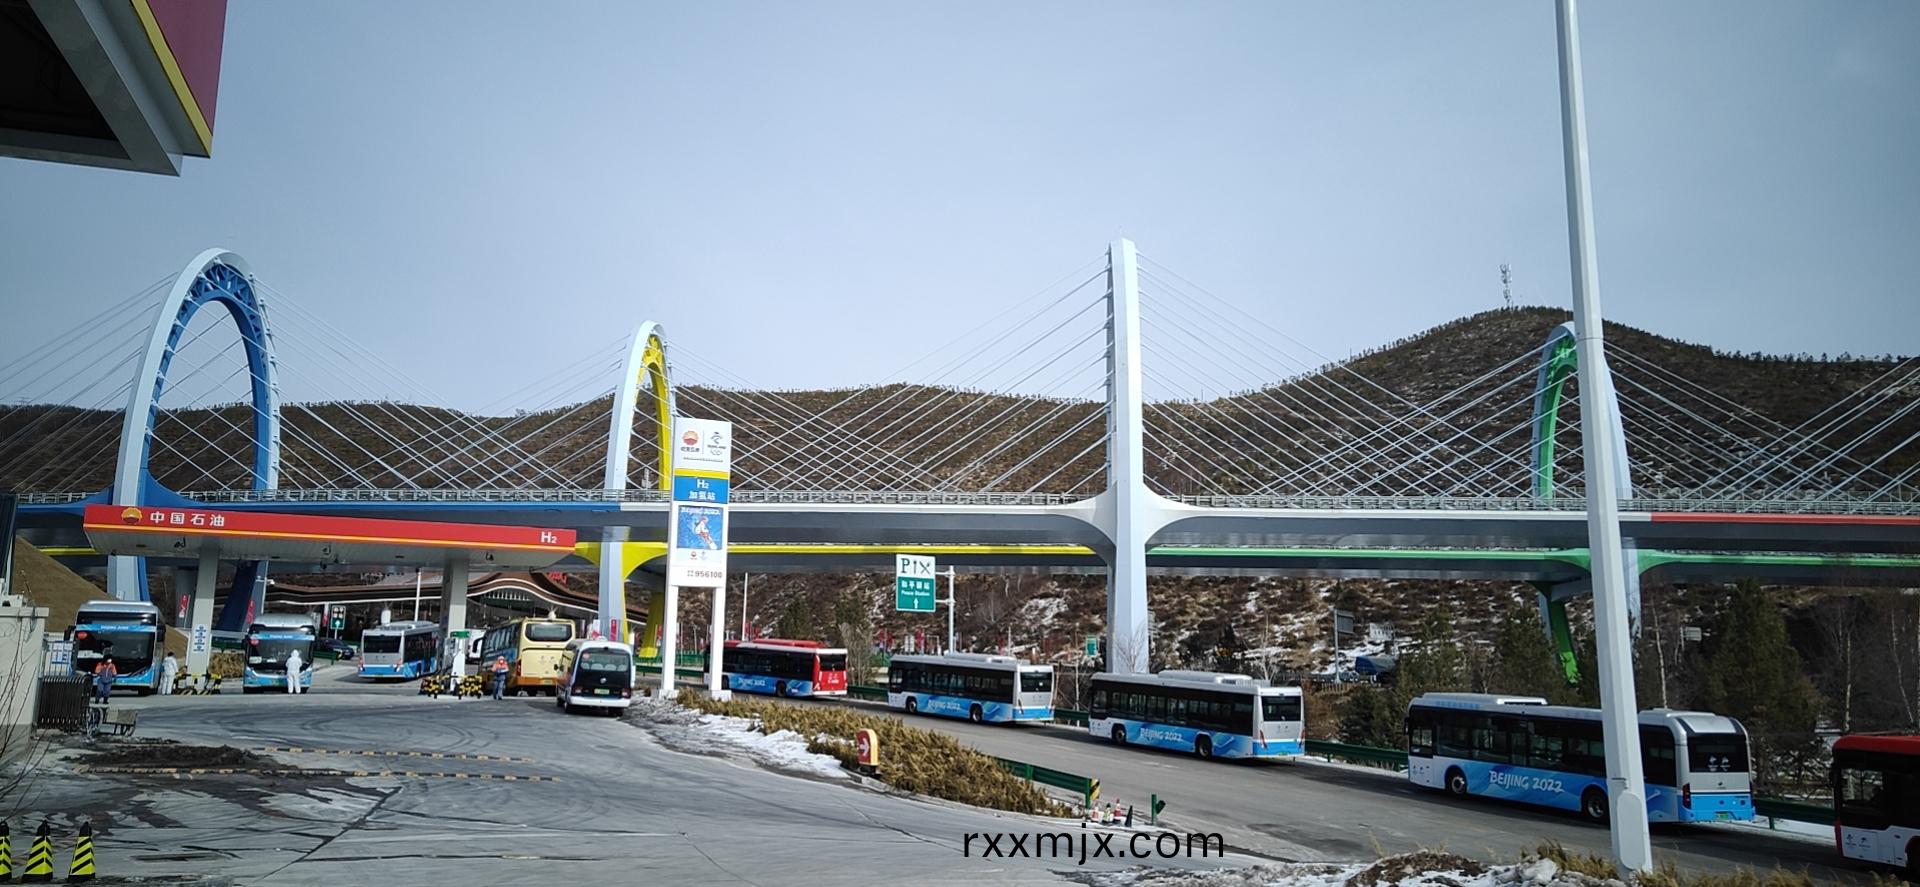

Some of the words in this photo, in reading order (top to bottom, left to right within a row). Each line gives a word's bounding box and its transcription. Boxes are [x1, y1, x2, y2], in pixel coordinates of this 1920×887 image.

[150, 511, 225, 527] 中国石油
[541, 531, 557, 544] H2
[1139, 727, 1164, 739] BEIJING
[1165, 732, 1183, 742] 2022
[1489, 770, 1530, 790] BEIJING
[1533, 777, 1565, 793] 2022
